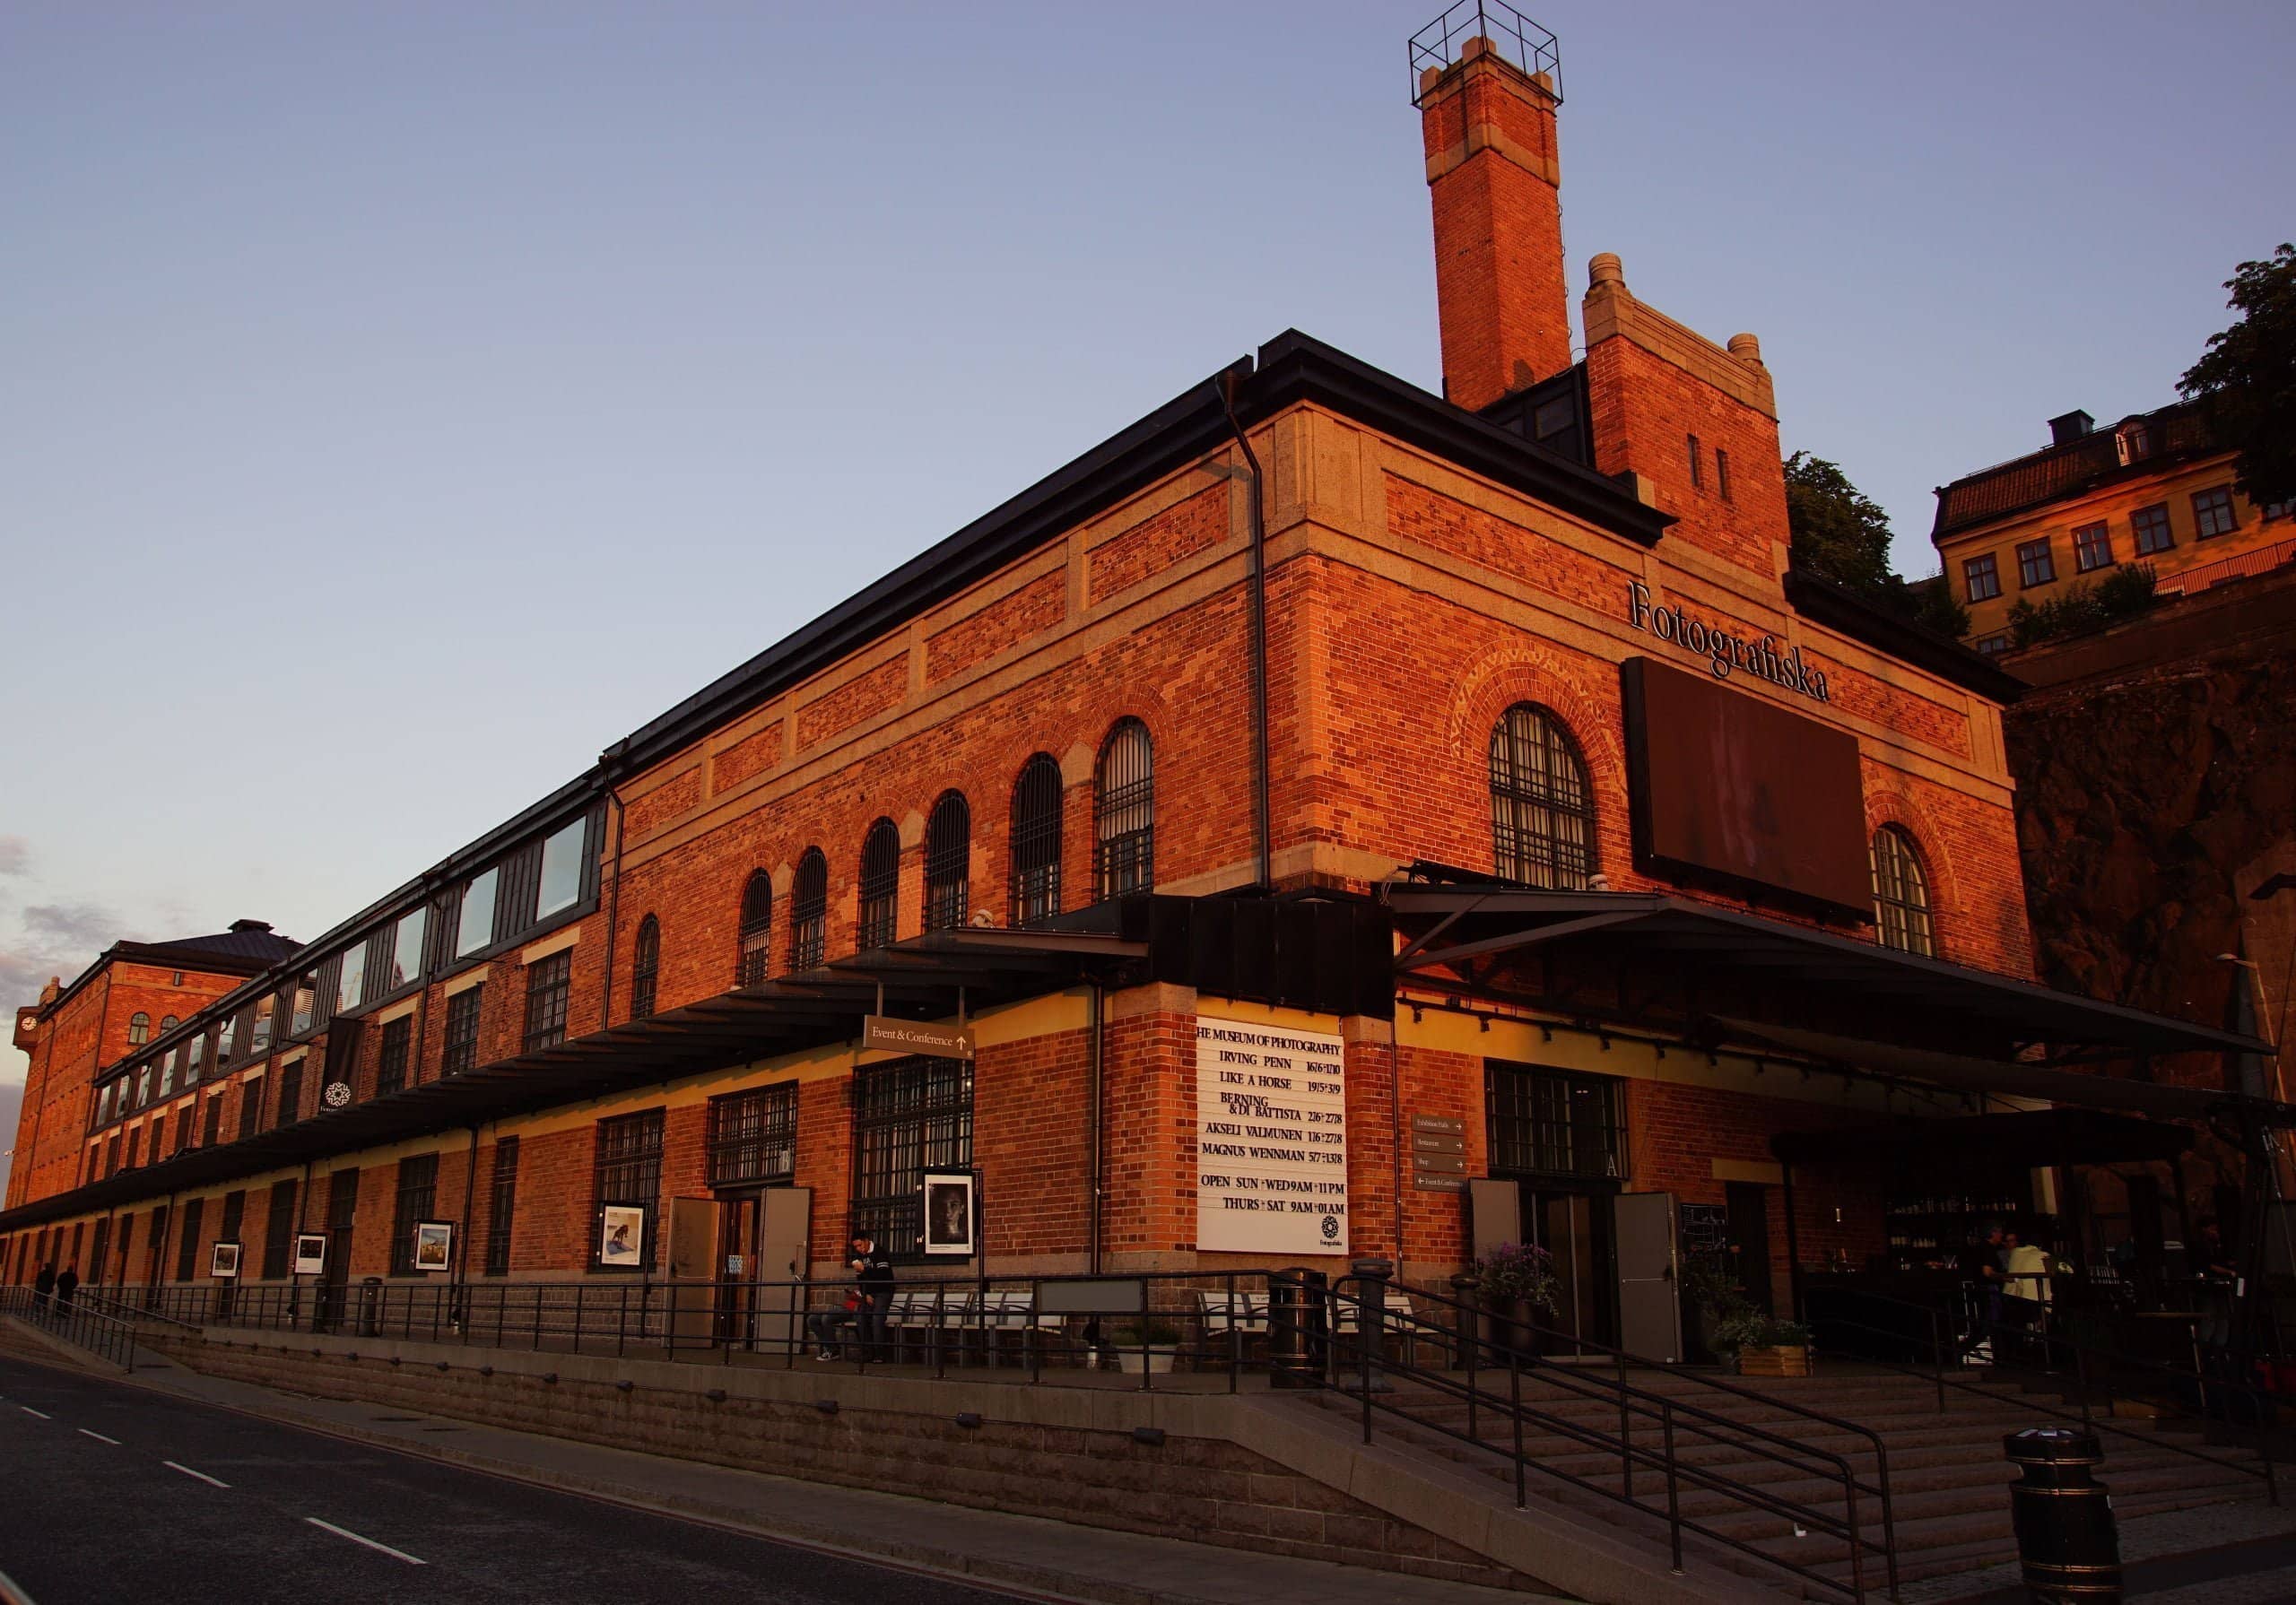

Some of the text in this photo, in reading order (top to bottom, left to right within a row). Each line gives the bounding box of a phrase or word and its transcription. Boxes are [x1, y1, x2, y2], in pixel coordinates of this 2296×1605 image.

[1627, 579, 1831, 703] Fotografiska
[872, 1026, 953, 1046] Event & Conference
[1196, 1027, 1341, 1055] HE MUSEUM OF PHOTOGRAPHY
[1220, 1050, 1257, 1065] IRVING
[1264, 1055, 1292, 1070] PENN
[1220, 1071, 1244, 1084] LIKE
[1248, 1074, 1255, 1086] A
[1258, 1075, 1292, 1089] HORSE
[1220, 1091, 1269, 1107] BERNING
[1229, 1103, 1237, 1115] &
[1239, 1104, 1249, 1116] DI
[1256, 1106, 1301, 1121] BATTISTA
[1205, 1122, 1241, 1136] AKSELI
[1246, 1125, 1302, 1141] VALMUNEN
[1202, 1142, 1246, 1157] MAGNUS
[1248, 1147, 1305, 1162] WENNMAN
[1606, 1154, 1618, 1176] A
[1201, 1174, 1231, 1187] OPEN
